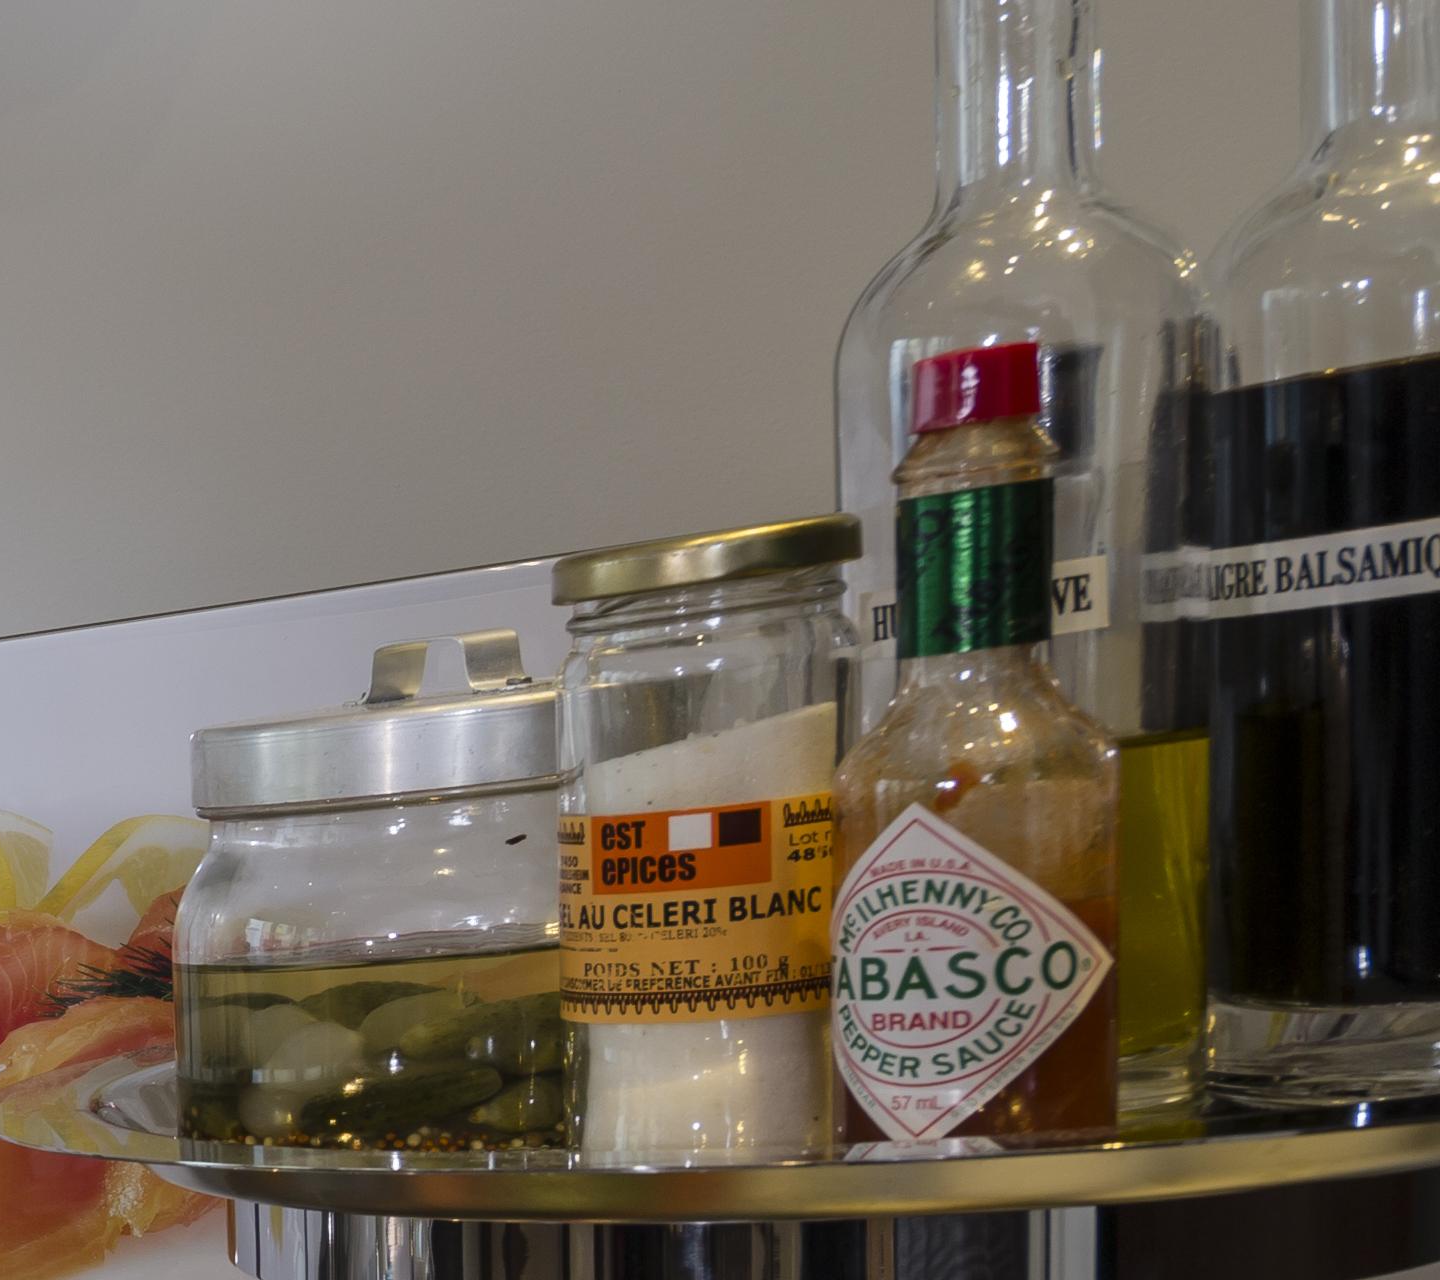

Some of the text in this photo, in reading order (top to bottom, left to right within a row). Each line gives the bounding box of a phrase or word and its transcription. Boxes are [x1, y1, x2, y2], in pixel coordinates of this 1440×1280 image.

[789, 831, 819, 846] Lot
[870, 859, 905, 878] MADE
[911, 859, 926, 869] IN
[579, 904, 605, 930] AU
[613, 898, 717, 929] CELERI
[729, 886, 822, 922] BLANC
[873, 916, 970, 939] AVERY ISLAND
[584, 961, 641, 978] POIDS
[651, 959, 700, 976] NET
[731, 954, 769, 971] 100
[832, 940, 1078, 1001] ABASCO
[715, 971, 761, 987] AVANT
[871, 1009, 973, 1032] BRAND
[838, 999, 1036, 1079] PEPPER SAUCE
[891, 1095, 912, 1111] 57
